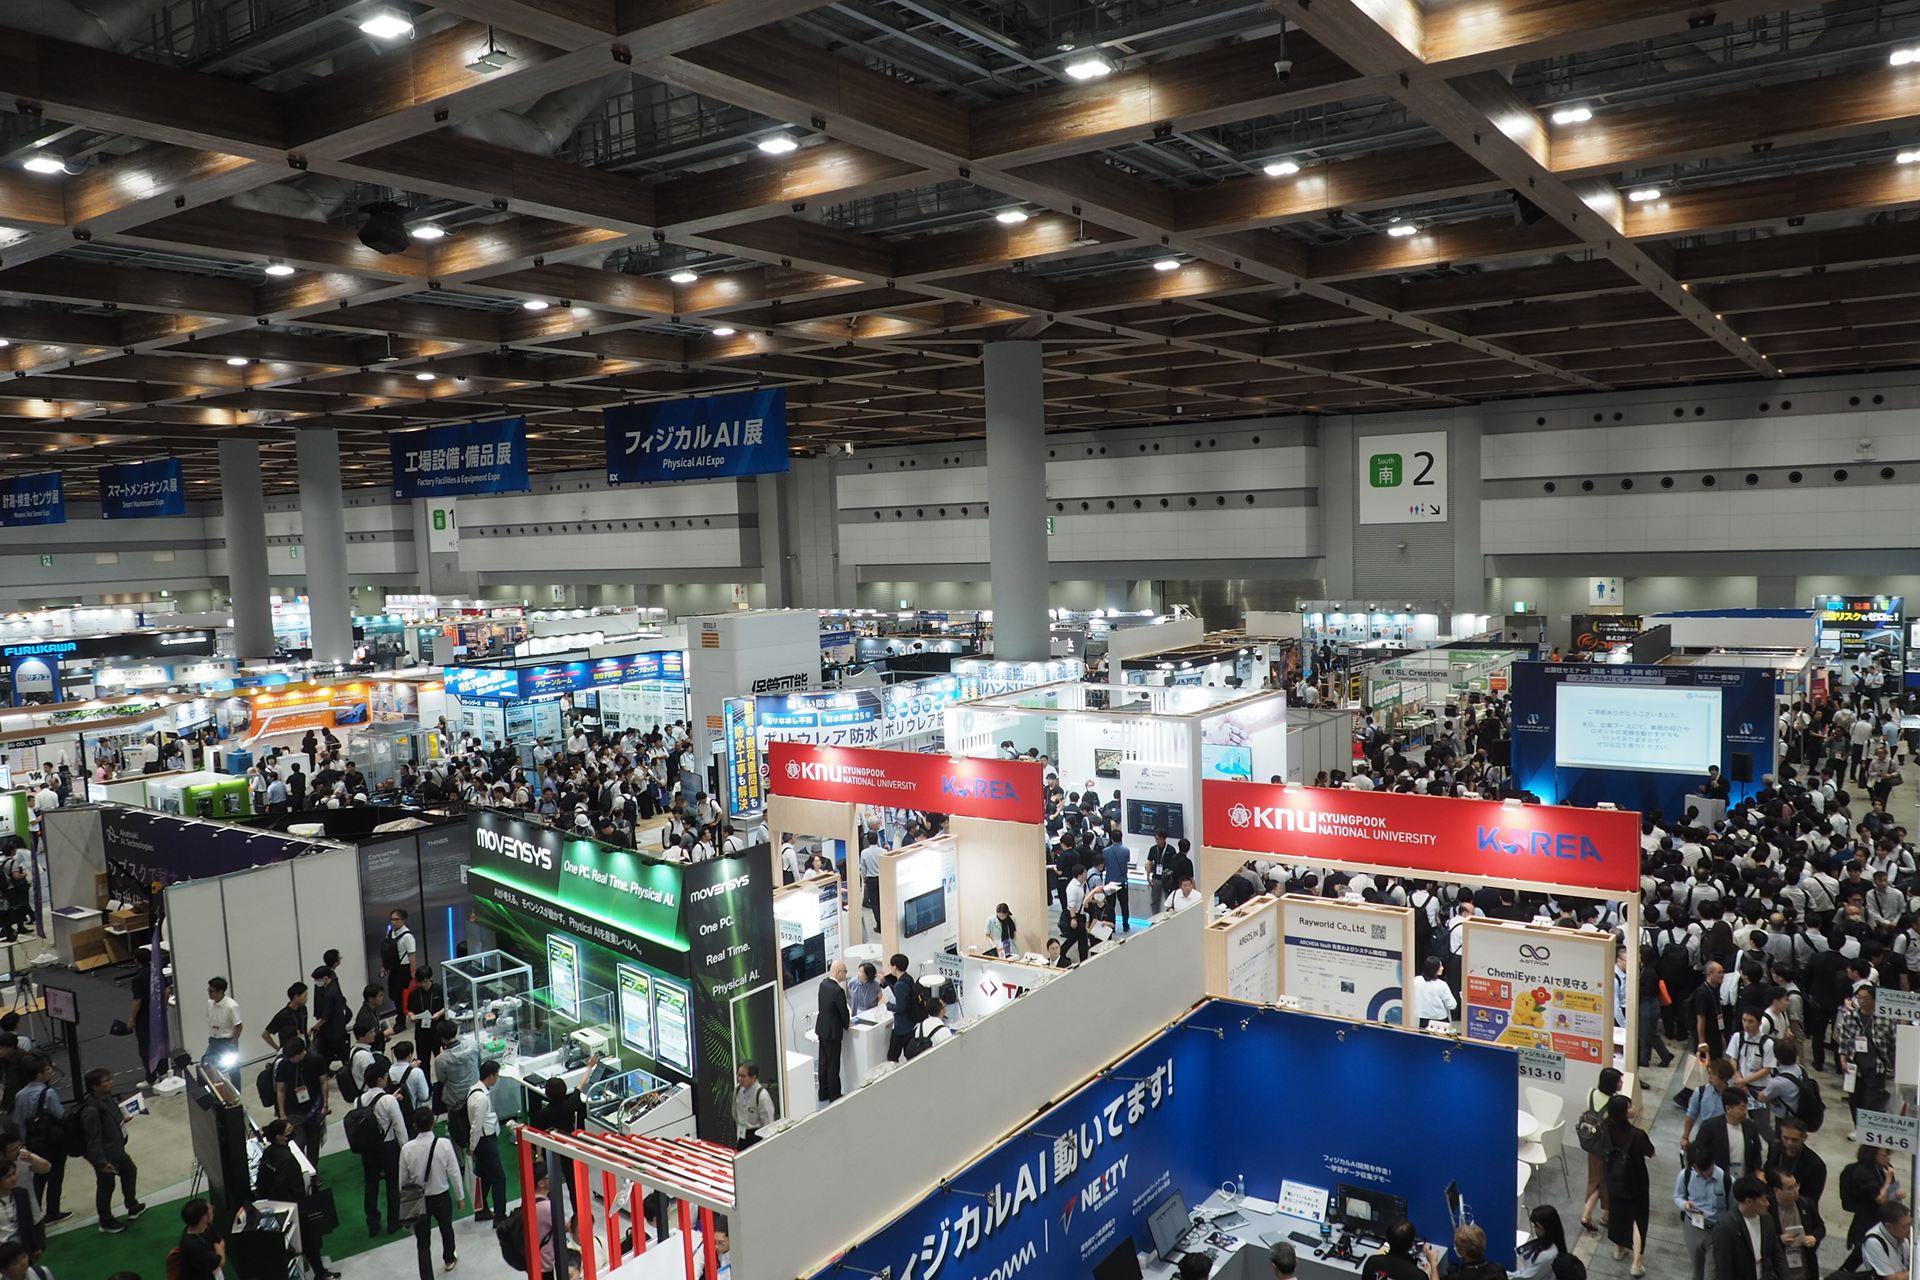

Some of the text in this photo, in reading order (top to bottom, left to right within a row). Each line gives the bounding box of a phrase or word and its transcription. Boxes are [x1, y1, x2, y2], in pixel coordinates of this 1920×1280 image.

[625, 419, 763, 455] フィジカルAI展
[405, 442, 511, 472] 工場設備・備品展
[663, 456, 725, 470] Physical AI Expo
[1378, 466, 1393, 484] 南
[1413, 451, 1434, 486] 2
[108, 479, 177, 497] スマートメンテナンス展
[417, 477, 434, 487] Factory
[435, 475, 456, 485] Facilities
[461, 473, 487, 484] Equipment
[488, 472, 500, 482] Expo
[449, 509, 454, 529] 1
[5, 643, 76, 656] FURUKAWA
[1396, 669, 1405, 677] SL
[1407, 669, 1448, 678] Creations
[843, 765, 886, 780] KYUNGPOOK
[843, 775, 918, 792] NATIONAL UNIVERSITY
[942, 774, 1020, 801] KOREA
[1317, 810, 1387, 828] KYUNGPOOK
[1317, 823, 1437, 847] NATIONAL UNIVERSITY
[1476, 823, 1605, 863] KOREA
[564, 860, 675, 908] One PC. Real Time. Physical AI.
[568, 916, 594, 936] Physical
[699, 915, 736, 937] One PC.
[1299, 917, 1336, 931] Rayworld
[780, 932, 802, 942] S12-10
[706, 942, 751, 967] Real Time.
[1519, 958, 1550, 967] ASTRON
[712, 969, 760, 997] Physical AI.
[1879, 1005, 1920, 1019] S14-10
[1519, 1065, 1562, 1081] S13-10
[1866, 1132, 1909, 1150] S14-6
[1081, 1153, 1128, 1213] NEXTY
[1094, 1187, 1119, 1212] ELECTRONICS
